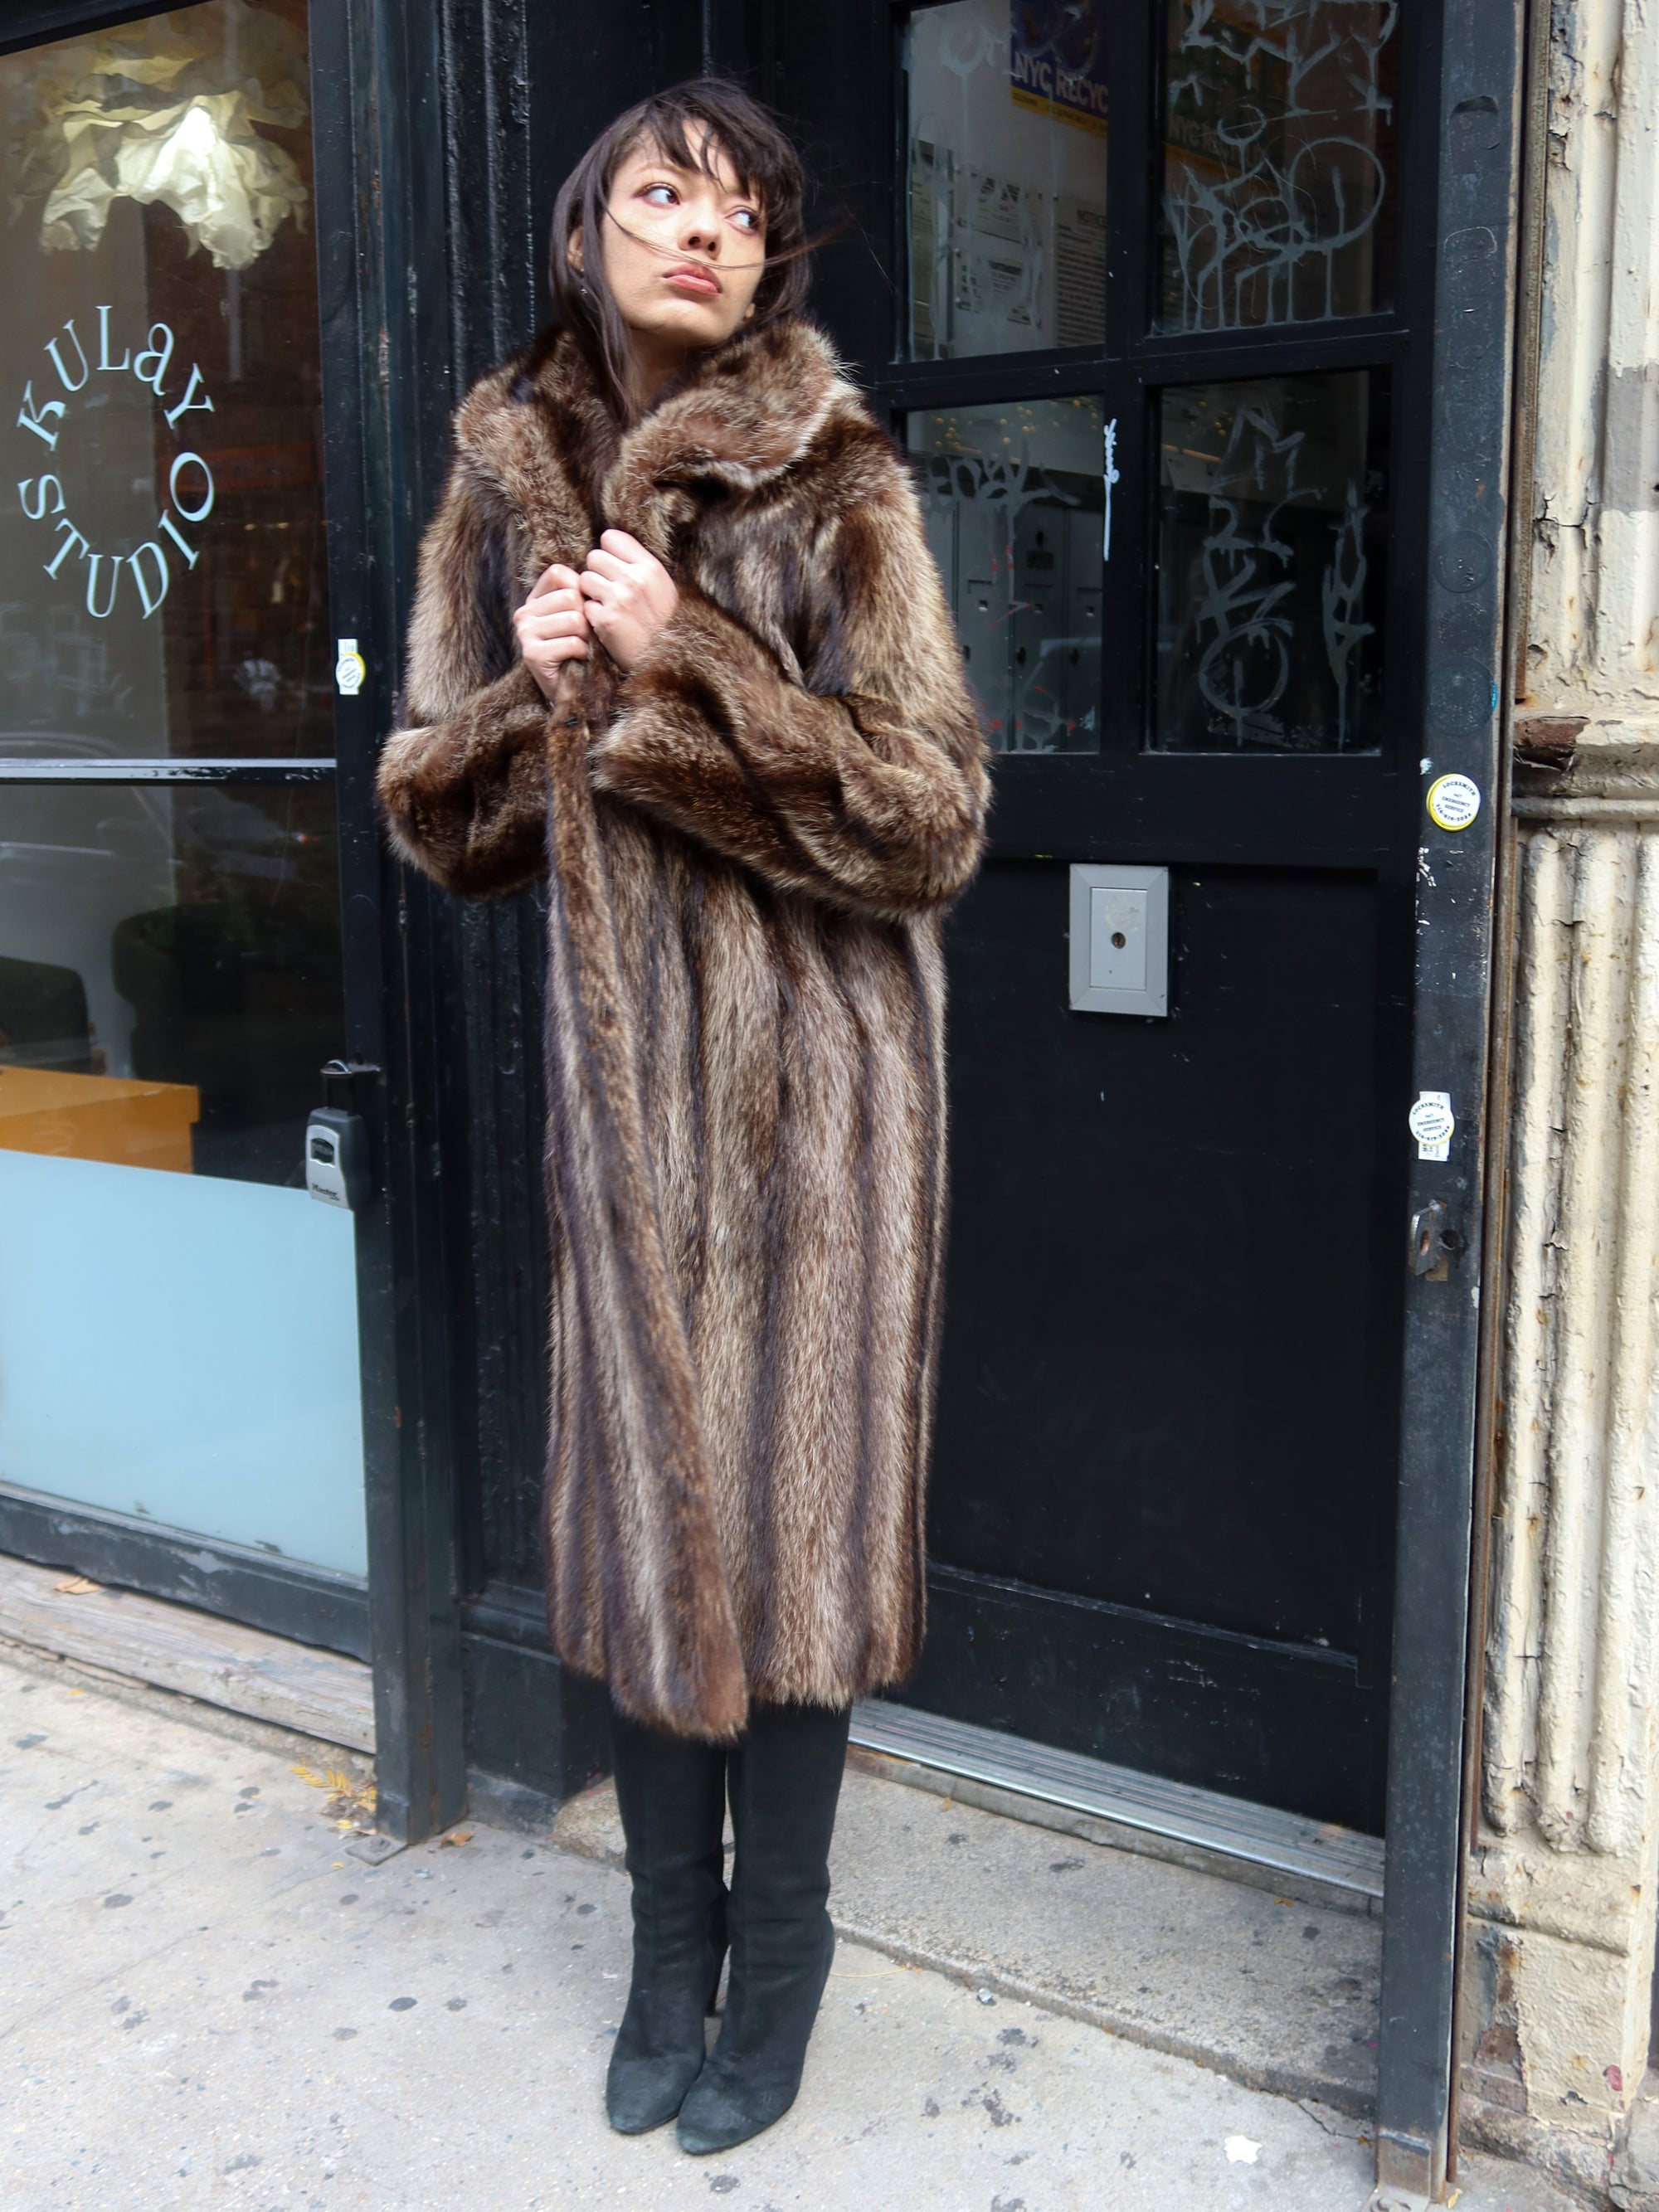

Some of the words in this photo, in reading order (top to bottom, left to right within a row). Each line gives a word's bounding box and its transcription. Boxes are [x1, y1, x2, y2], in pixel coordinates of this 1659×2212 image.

[1014, 51, 1052, 92] NYC
[17, 451, 215, 620] STUDIO
[1443, 781, 1476, 796] LOCKSMITH
[1443, 797, 1471, 807] EMERGENCY
[1445, 805, 1465, 813] SERVICE
[1413, 1102, 1444, 1115] LOCKSMITH
[1418, 1118, 1444, 1126] EMERGENCY
